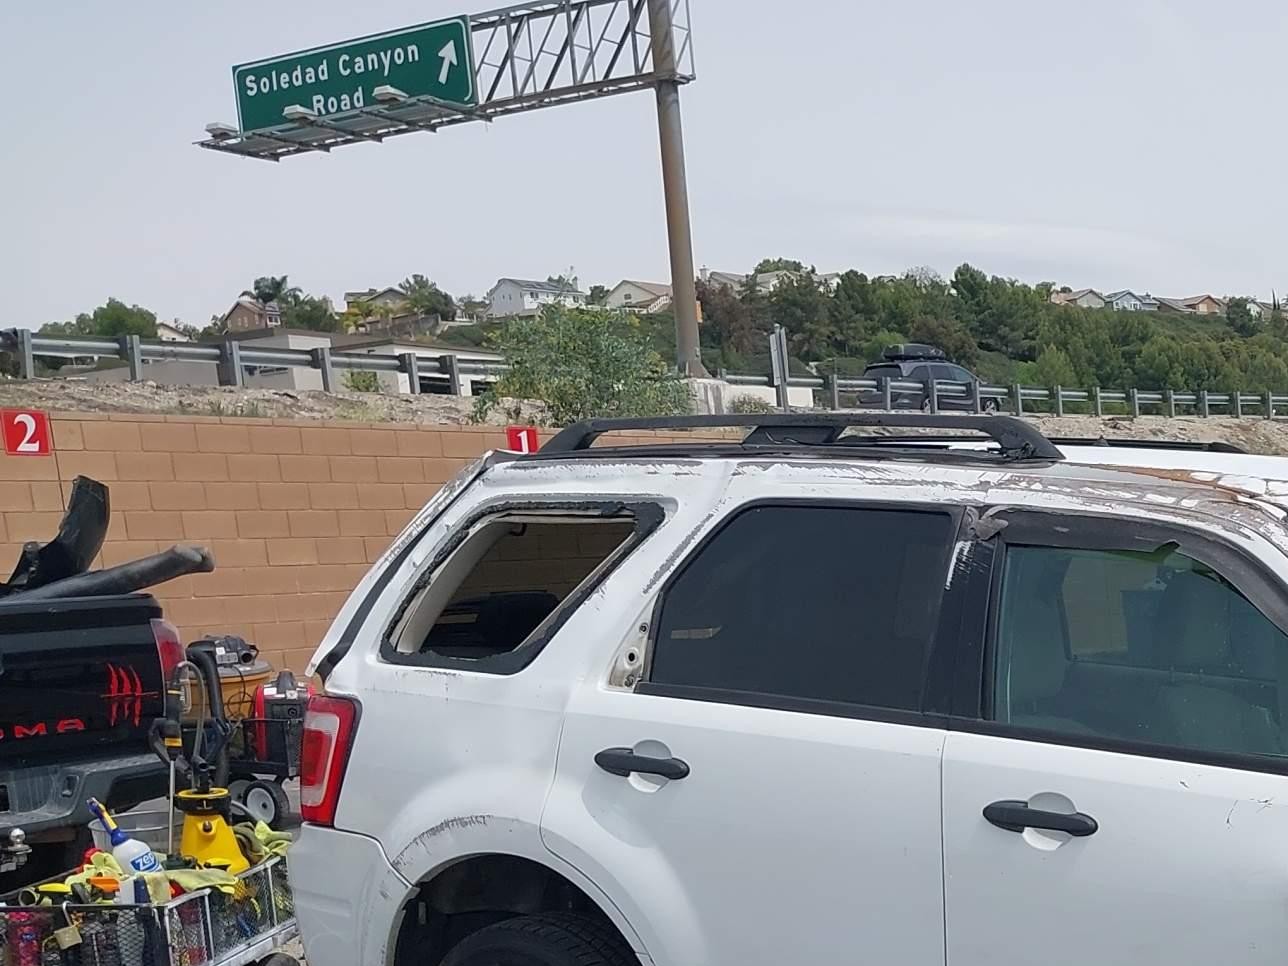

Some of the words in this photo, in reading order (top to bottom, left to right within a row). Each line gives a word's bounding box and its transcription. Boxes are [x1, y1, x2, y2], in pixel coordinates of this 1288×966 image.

[245, 59, 329, 97] Soledad
[338, 44, 419, 77] Canyon
[312, 86, 364, 116] Road
[13, 413, 40, 452] 2
[516, 430, 529, 454] 1
[0, 719, 86, 739] MA
